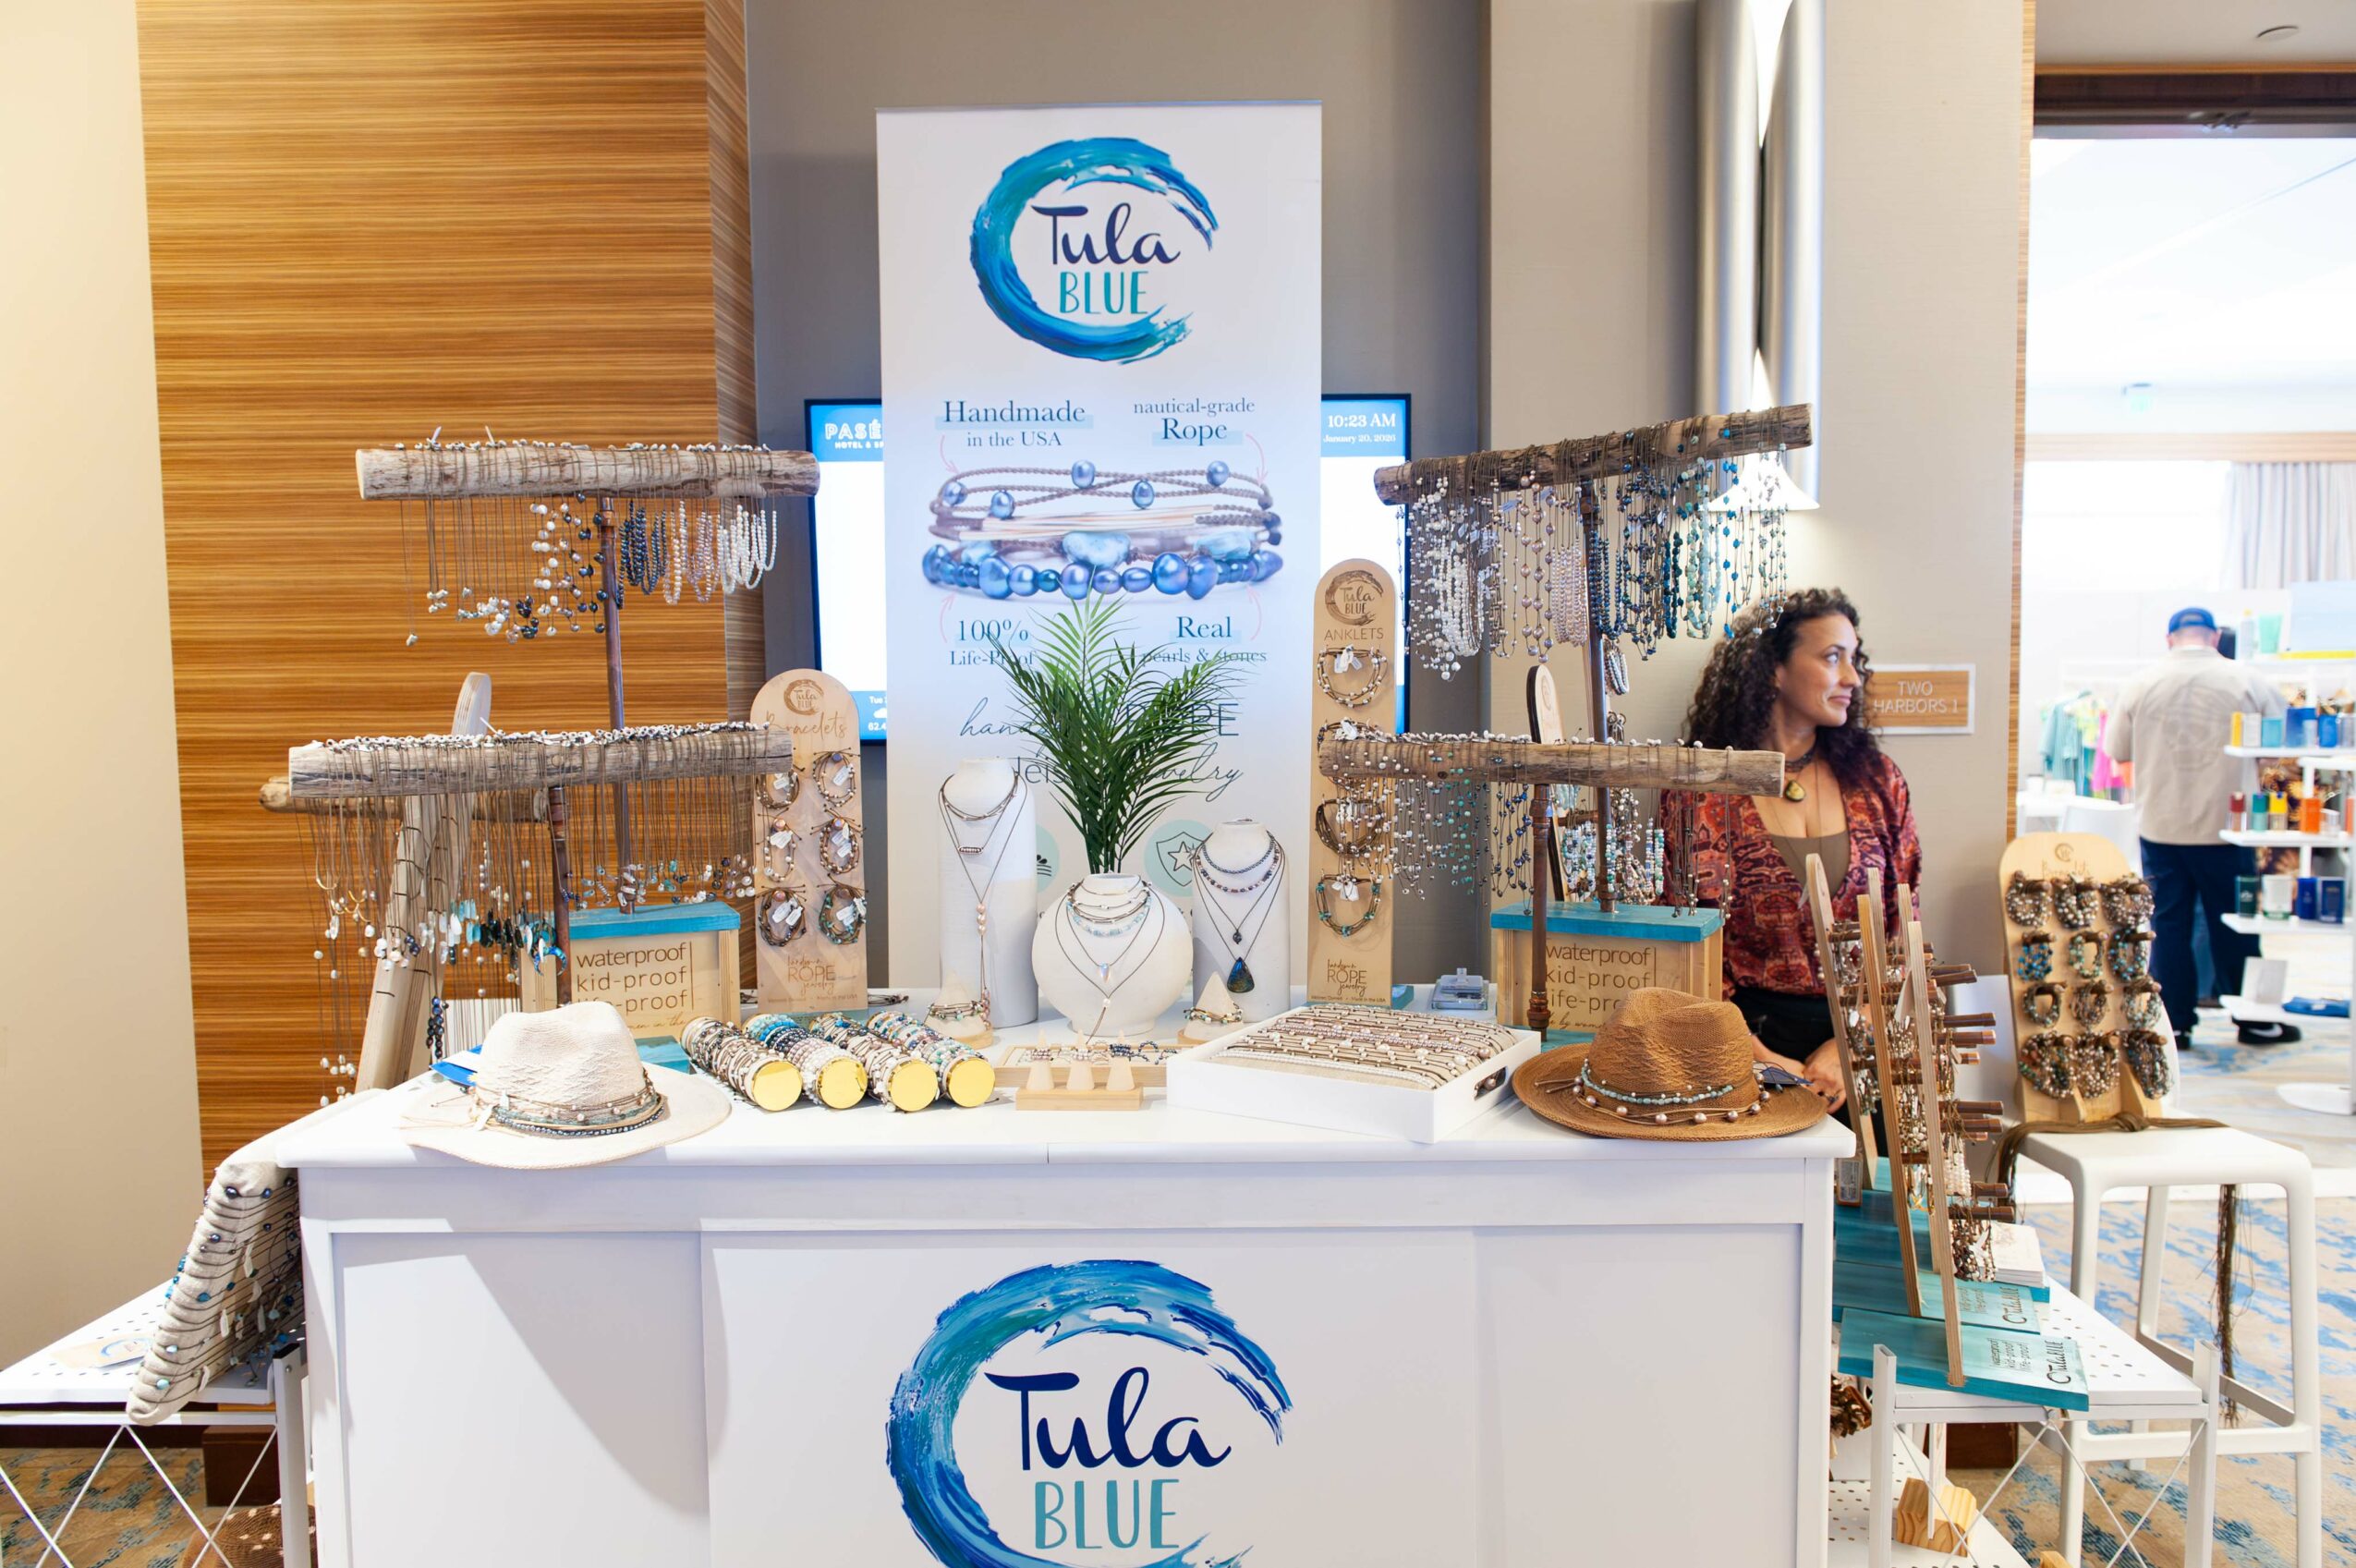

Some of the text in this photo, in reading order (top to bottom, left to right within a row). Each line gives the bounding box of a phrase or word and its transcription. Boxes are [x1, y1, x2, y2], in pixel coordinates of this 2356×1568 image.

[1030, 202, 1181, 266] Tula
[1059, 271, 1149, 315] BLUE
[942, 399, 1087, 423] Handmade
[1133, 397, 1256, 417] nautical-grade
[1160, 417, 1227, 446] Rope
[1328, 413, 1396, 428] 10:23 AM
[967, 431, 1063, 447] in the USA
[1323, 434, 1355, 444] January
[1340, 586, 1375, 602] Tula
[1345, 602, 1367, 614] BLUE
[958, 619, 1028, 641] 100%
[1176, 615, 1233, 638] Real
[1324, 627, 1384, 641] ANKLETS
[1142, 648, 1191, 667] pearls
[1196, 648, 1209, 662] &
[1898, 679, 1934, 696] TWO
[1874, 699, 1959, 713] HARBORS 1
[577, 942, 687, 967] waterproof
[1546, 943, 1651, 966] waterproof
[577, 966, 687, 991] kid-proof
[788, 966, 835, 982] ROPE
[1327, 969, 1367, 983] ROPE
[1546, 965, 1651, 990] kid-proof
[577, 990, 687, 1015] -proof
[983, 1366, 1232, 1471] Tula
[1034, 1478, 1181, 1550] BLUE
